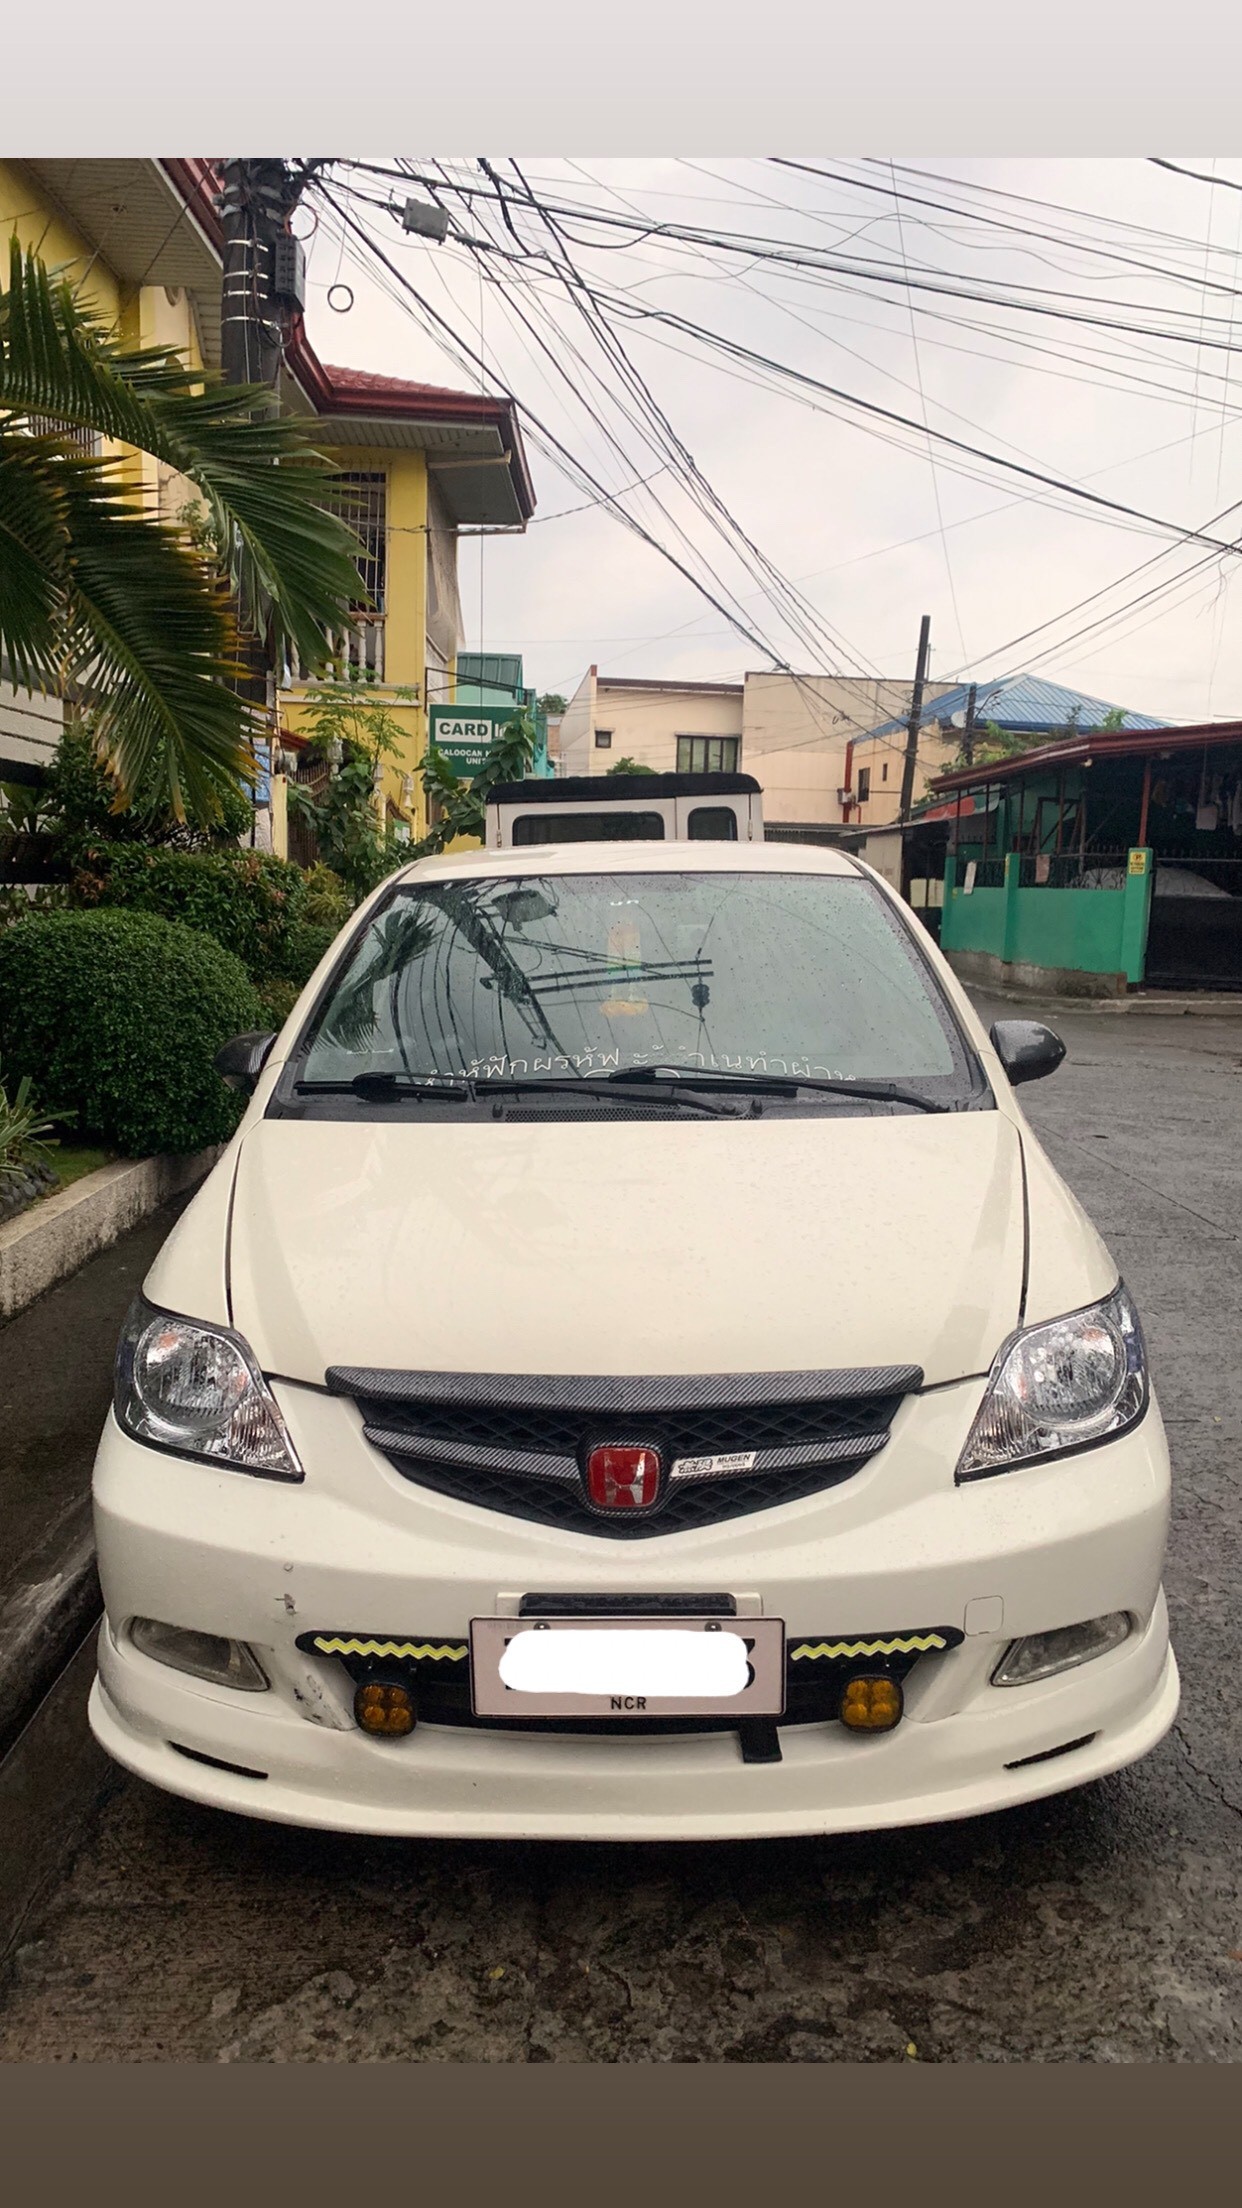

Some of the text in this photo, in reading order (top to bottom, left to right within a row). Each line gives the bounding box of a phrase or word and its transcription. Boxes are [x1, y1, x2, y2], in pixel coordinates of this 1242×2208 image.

[439, 722, 488, 736] CARD
[438, 748, 482, 757] CALOOCAN
[717, 1454, 751, 1464] MUGEN
[610, 1696, 647, 1710] NCR
